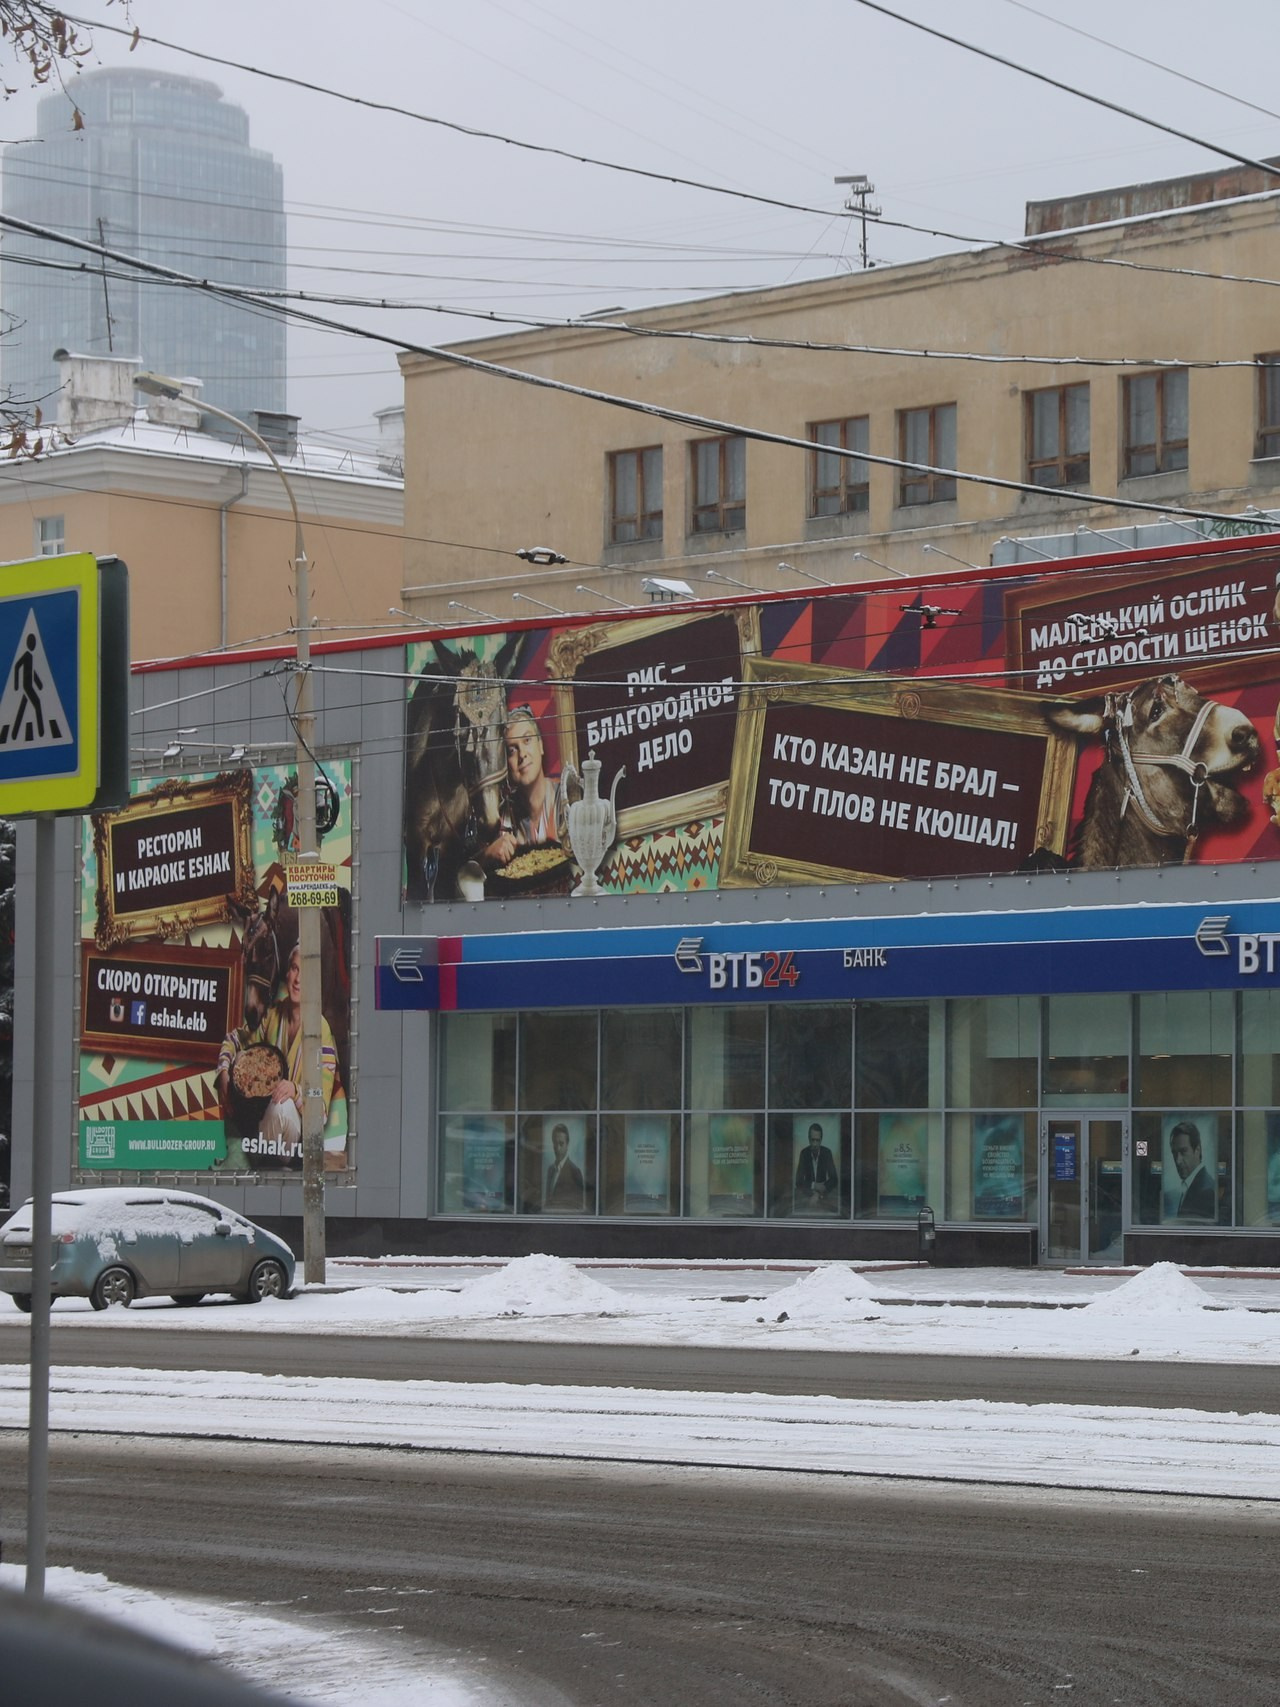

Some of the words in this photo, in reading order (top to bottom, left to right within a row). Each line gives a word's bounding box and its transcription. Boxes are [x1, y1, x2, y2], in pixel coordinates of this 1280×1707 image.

[1030, 595, 1164, 651] МАЛЕНЬКИЙ
[1170, 581, 1247, 620] ОСЛИК
[1036, 657, 1066, 689] ДО
[1071, 633, 1179, 677] СТАРОСТИ
[1185, 612, 1269, 653] ЩЕНОК
[627, 662, 667, 697] РИС
[587, 676, 735, 747] БЛАГОРОДНОЕ
[638, 728, 692, 772] ДЕЛО
[773, 733, 816, 766] КТО
[820, 742, 895, 780] КАЗАН
[899, 755, 931, 787] НЕ
[934, 761, 997, 798] БРАЛ
[769, 778, 810, 811] ТОТ
[812, 787, 875, 823] ПЛОВ
[879, 799, 912, 831] НЕ
[914, 806, 1018, 850] КЮШАЛ!
[137, 827, 202, 859] РЕСТОРАН
[116, 872, 126, 893] И
[128, 860, 186, 891] КАРАОКЕ
[188, 850, 231, 878] ESHAK
[288, 865, 335, 874] КВАРТИРЫ
[289, 873, 336, 882] ПОСУТОЧНО
[290, 891, 336, 906] 268-69-69
[97, 968, 141, 994] СКОРО
[144, 973, 218, 1002] ОТКРЫТИЕ
[709, 951, 798, 988] ВТБ24
[843, 949, 885, 968] БАНК
[150, 1007, 207, 1032] eshak.ekb
[128, 1139, 216, 1151] WWW.BULLDOZER-GROUP.RU
[241, 1131, 304, 1158] eshak.ru
